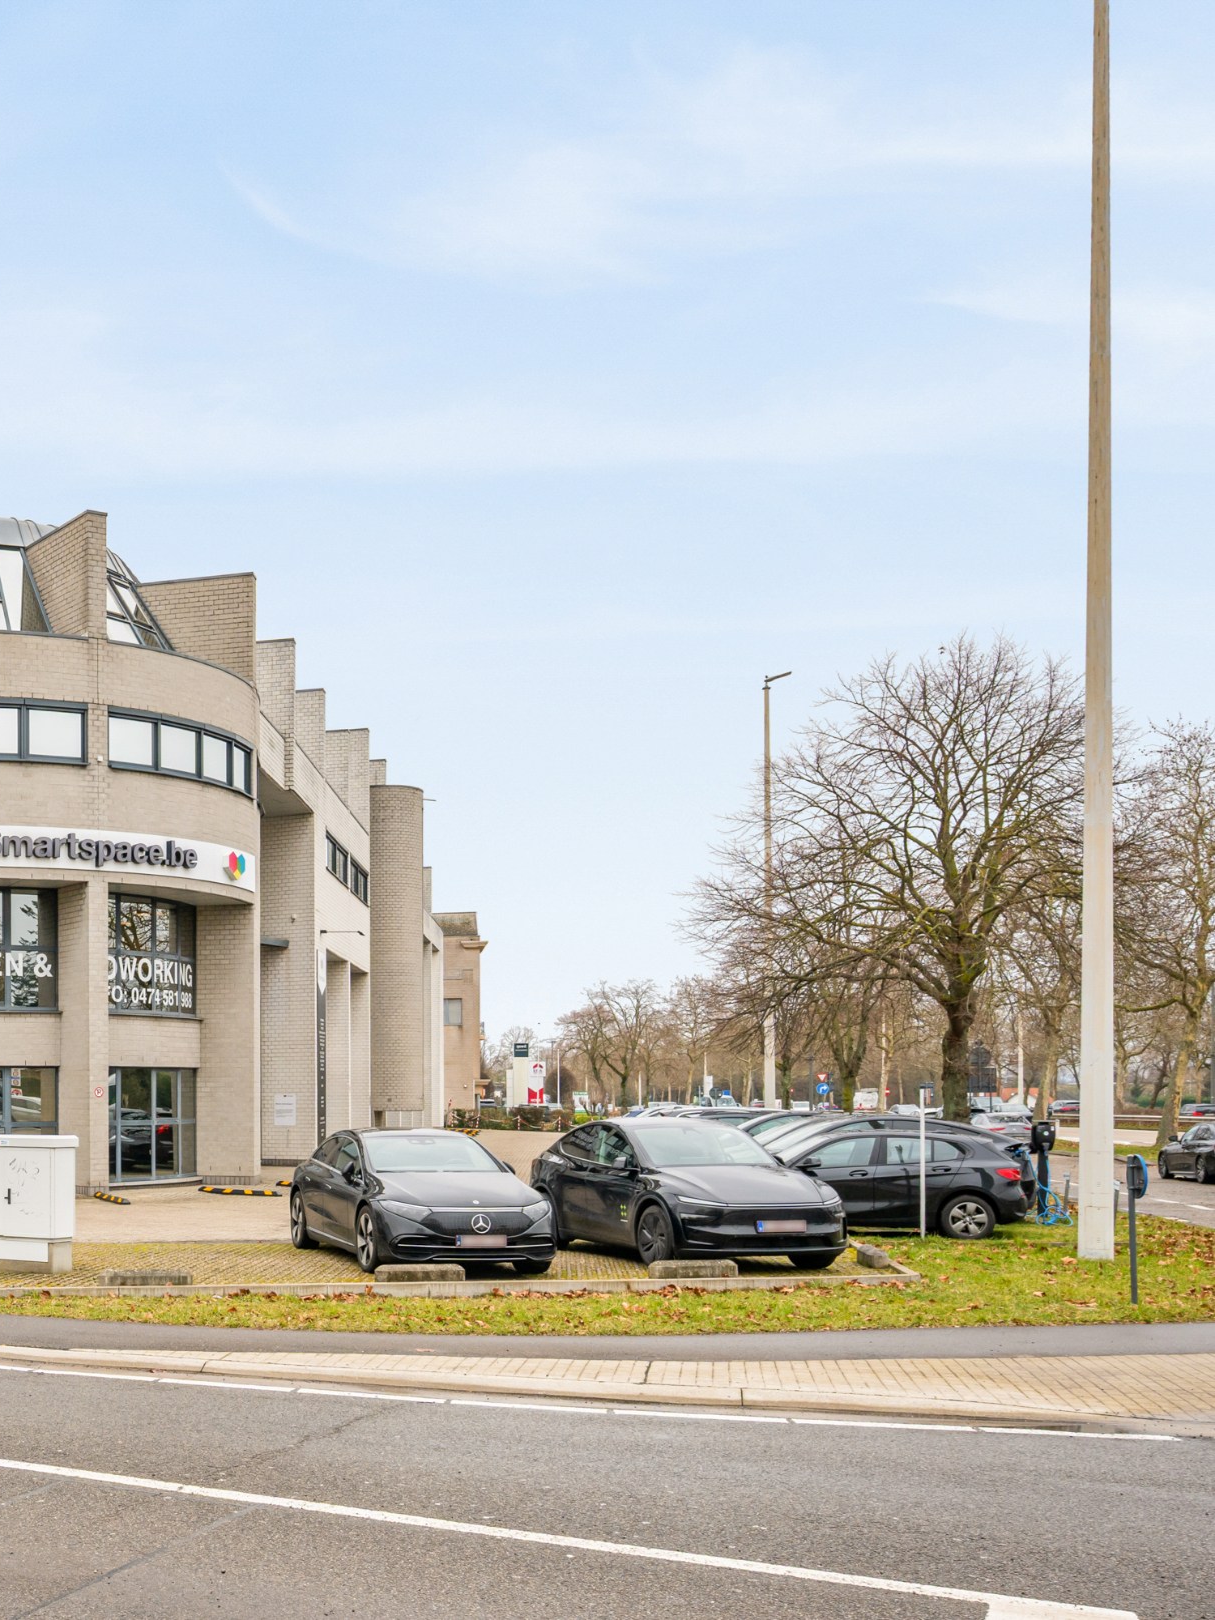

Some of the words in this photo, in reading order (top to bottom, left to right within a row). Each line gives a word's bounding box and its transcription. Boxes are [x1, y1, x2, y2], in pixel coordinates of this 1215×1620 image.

[33, 953, 54, 978] &
[131, 987, 161, 1005] 0474
[162, 989, 179, 1007] 581
